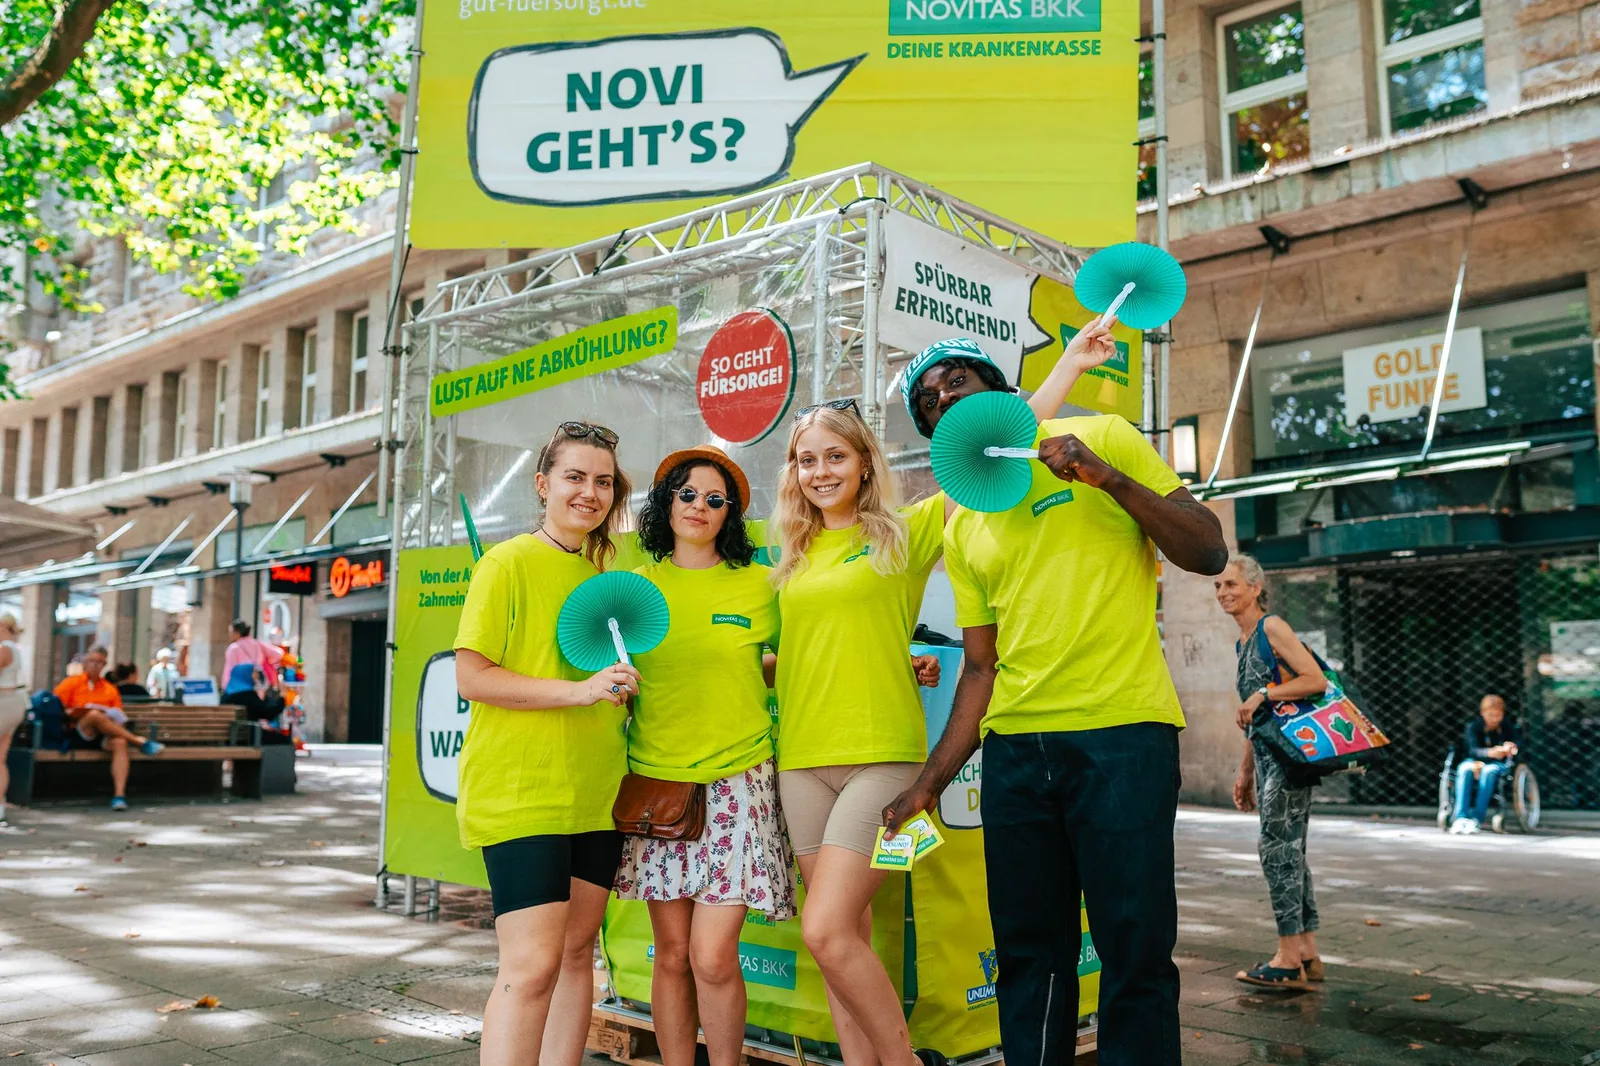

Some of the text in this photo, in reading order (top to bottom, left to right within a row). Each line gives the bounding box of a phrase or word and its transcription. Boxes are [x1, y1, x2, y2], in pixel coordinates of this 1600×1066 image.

[905, 0, 1086, 20] NOVITAS BKK
[887, 40, 1101, 59] DEINE KRANKENKASSE
[566, 64, 703, 113] NOVI
[526, 117, 746, 174] GEHT'S?
[914, 261, 993, 307] SPÜRBAR
[894, 286, 1017, 344] ERFRISCHEND!
[435, 319, 668, 406] LUST AUF NE ABKÜHLUNG?
[710, 346, 774, 375] SO GEHT
[1373, 343, 1446, 380] GOLD
[700, 365, 783, 398] FÜRSORGE!
[1367, 372, 1460, 413] FUNKE
[1034, 497, 1057, 512] NOVITAS
[420, 567, 472, 584] Von der A
[419, 590, 468, 607] Zahnrein
[762, 959, 788, 977] BKK
